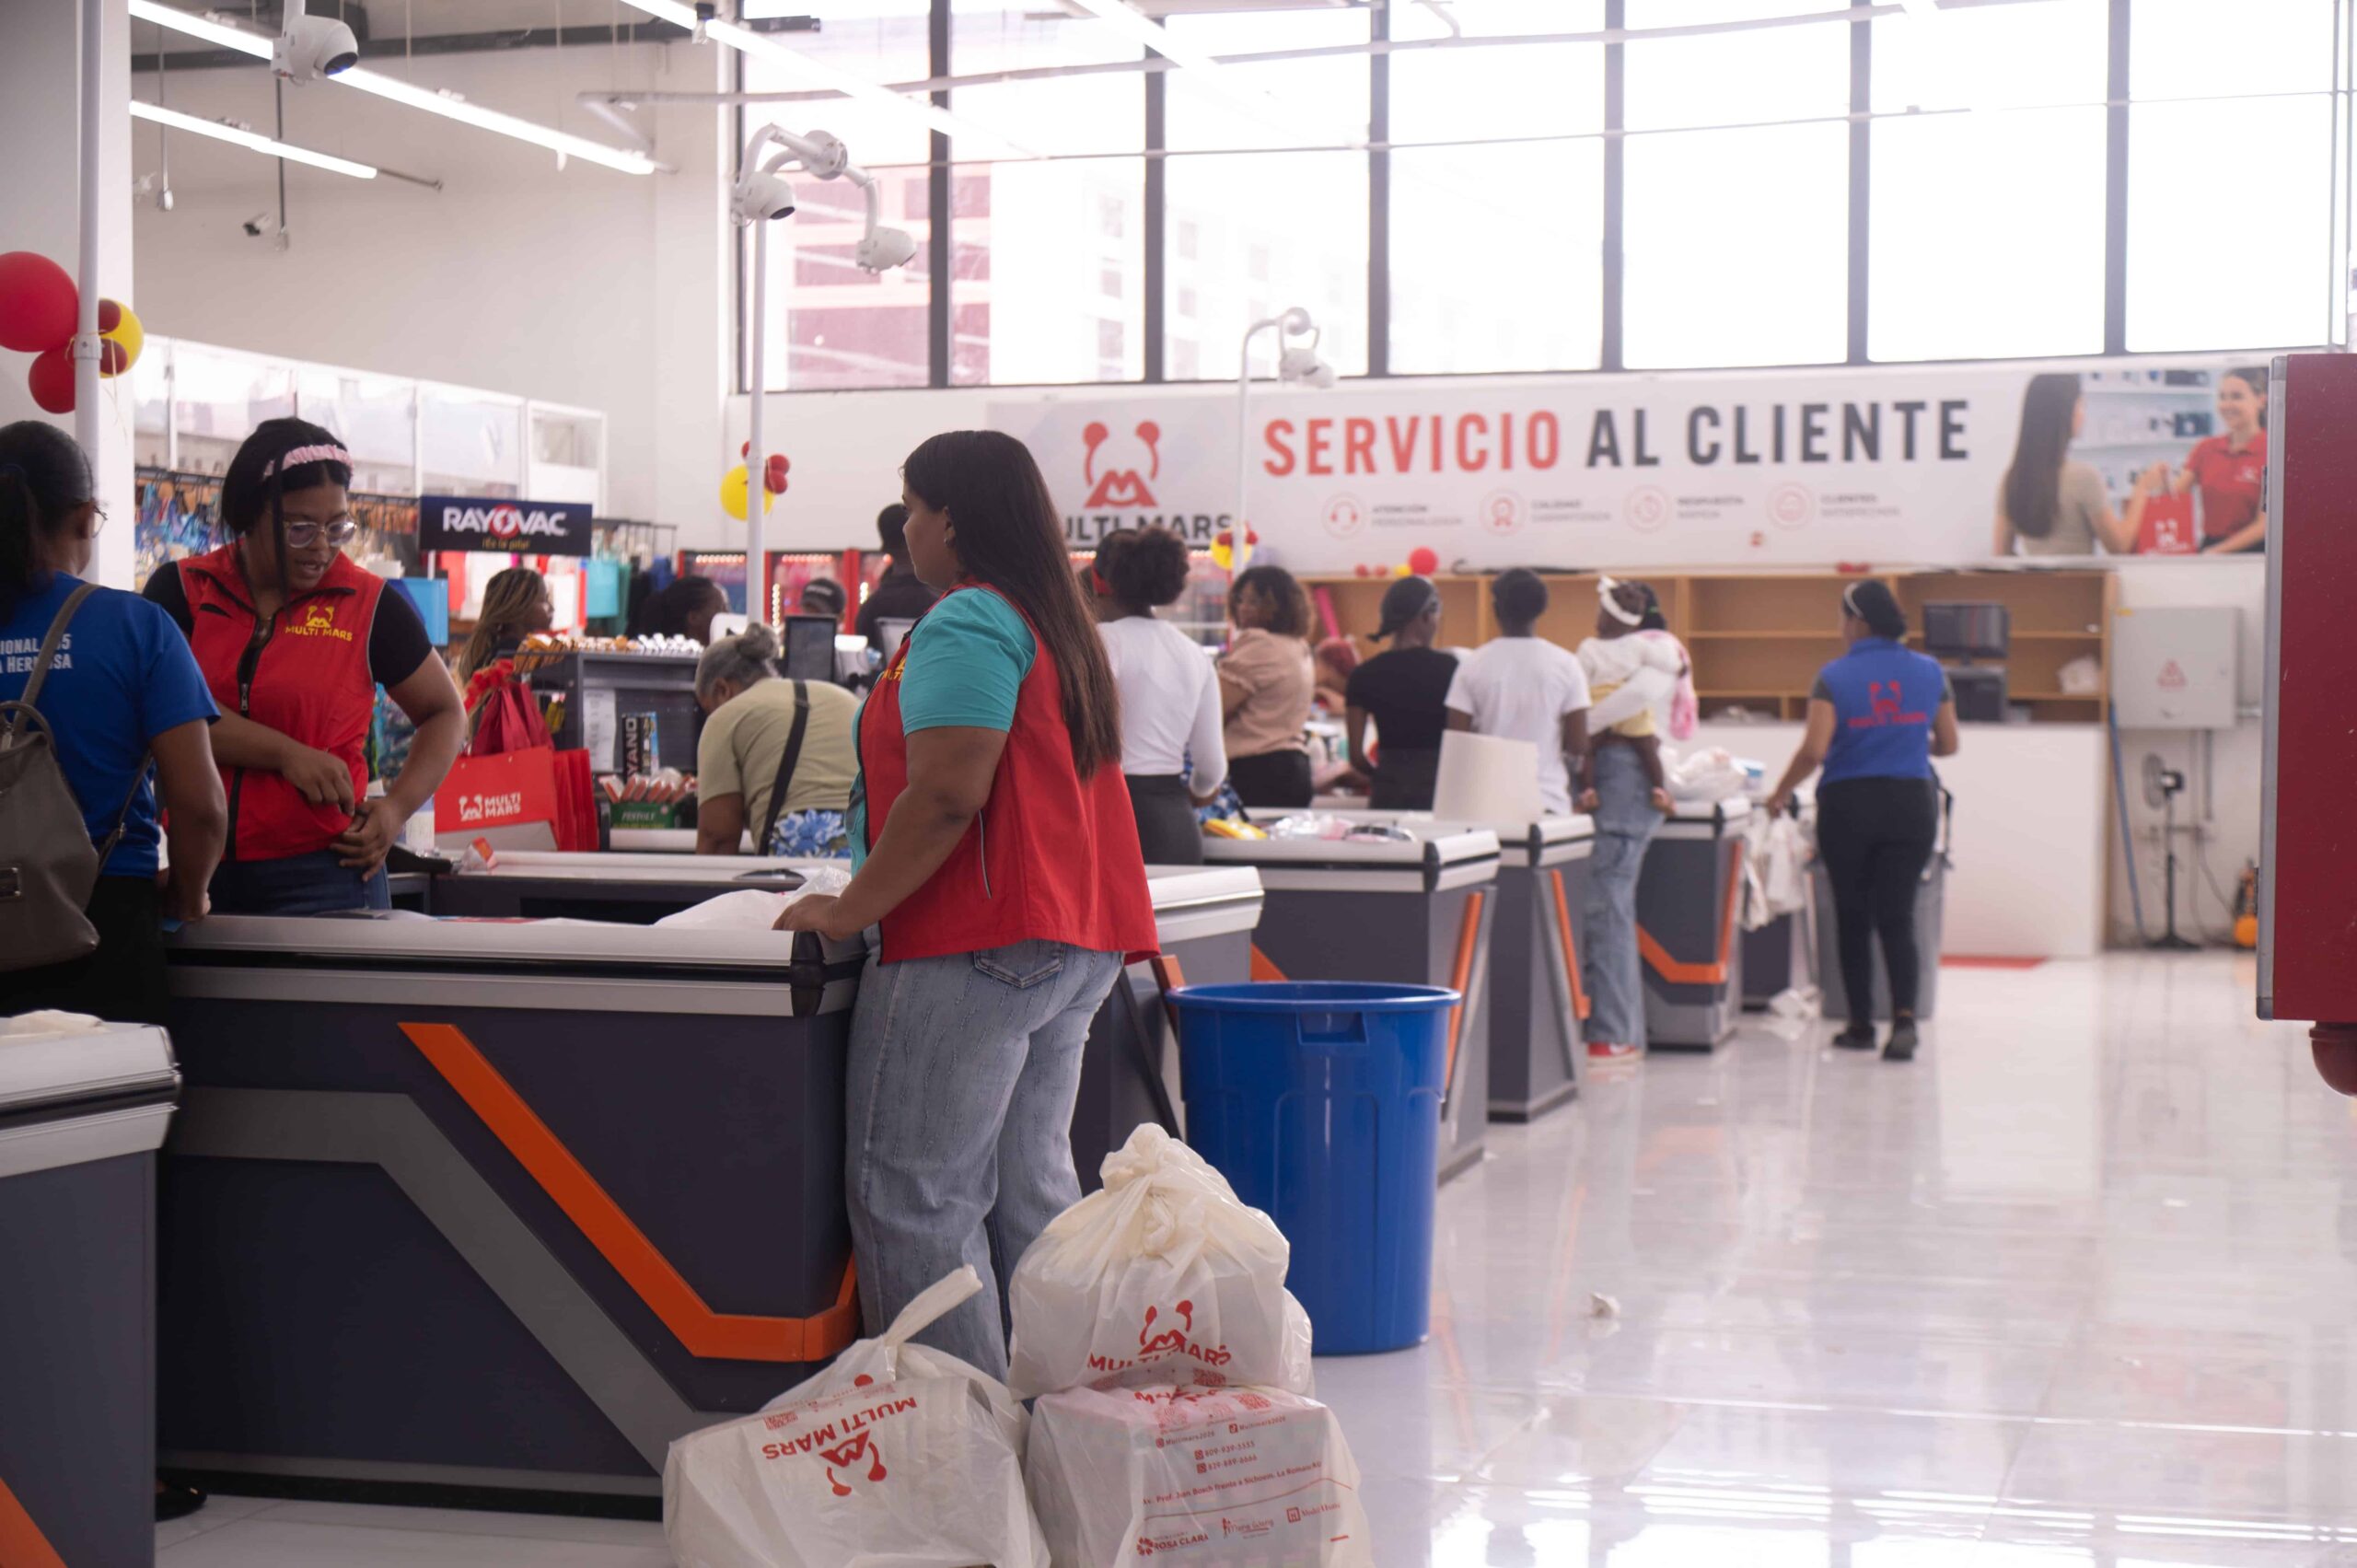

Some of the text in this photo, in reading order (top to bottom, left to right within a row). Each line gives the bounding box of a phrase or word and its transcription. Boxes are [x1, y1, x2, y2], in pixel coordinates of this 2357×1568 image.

[1264, 400, 1969, 477] SERVICIO AL CLIENTE
[443, 506, 567, 537] RAYOVAC
[1066, 515, 1120, 541] LTI
[285, 626, 354, 642] MULTI MARS
[6, 654, 73, 673] HERSA
[484, 792, 521, 807] MULTI
[484, 804, 521, 819] MARS
[761, 1397, 918, 1459] MULTI MARS
[1155, 1539, 1178, 1551] ROSA
[1179, 1532, 1209, 1547] CLARA
